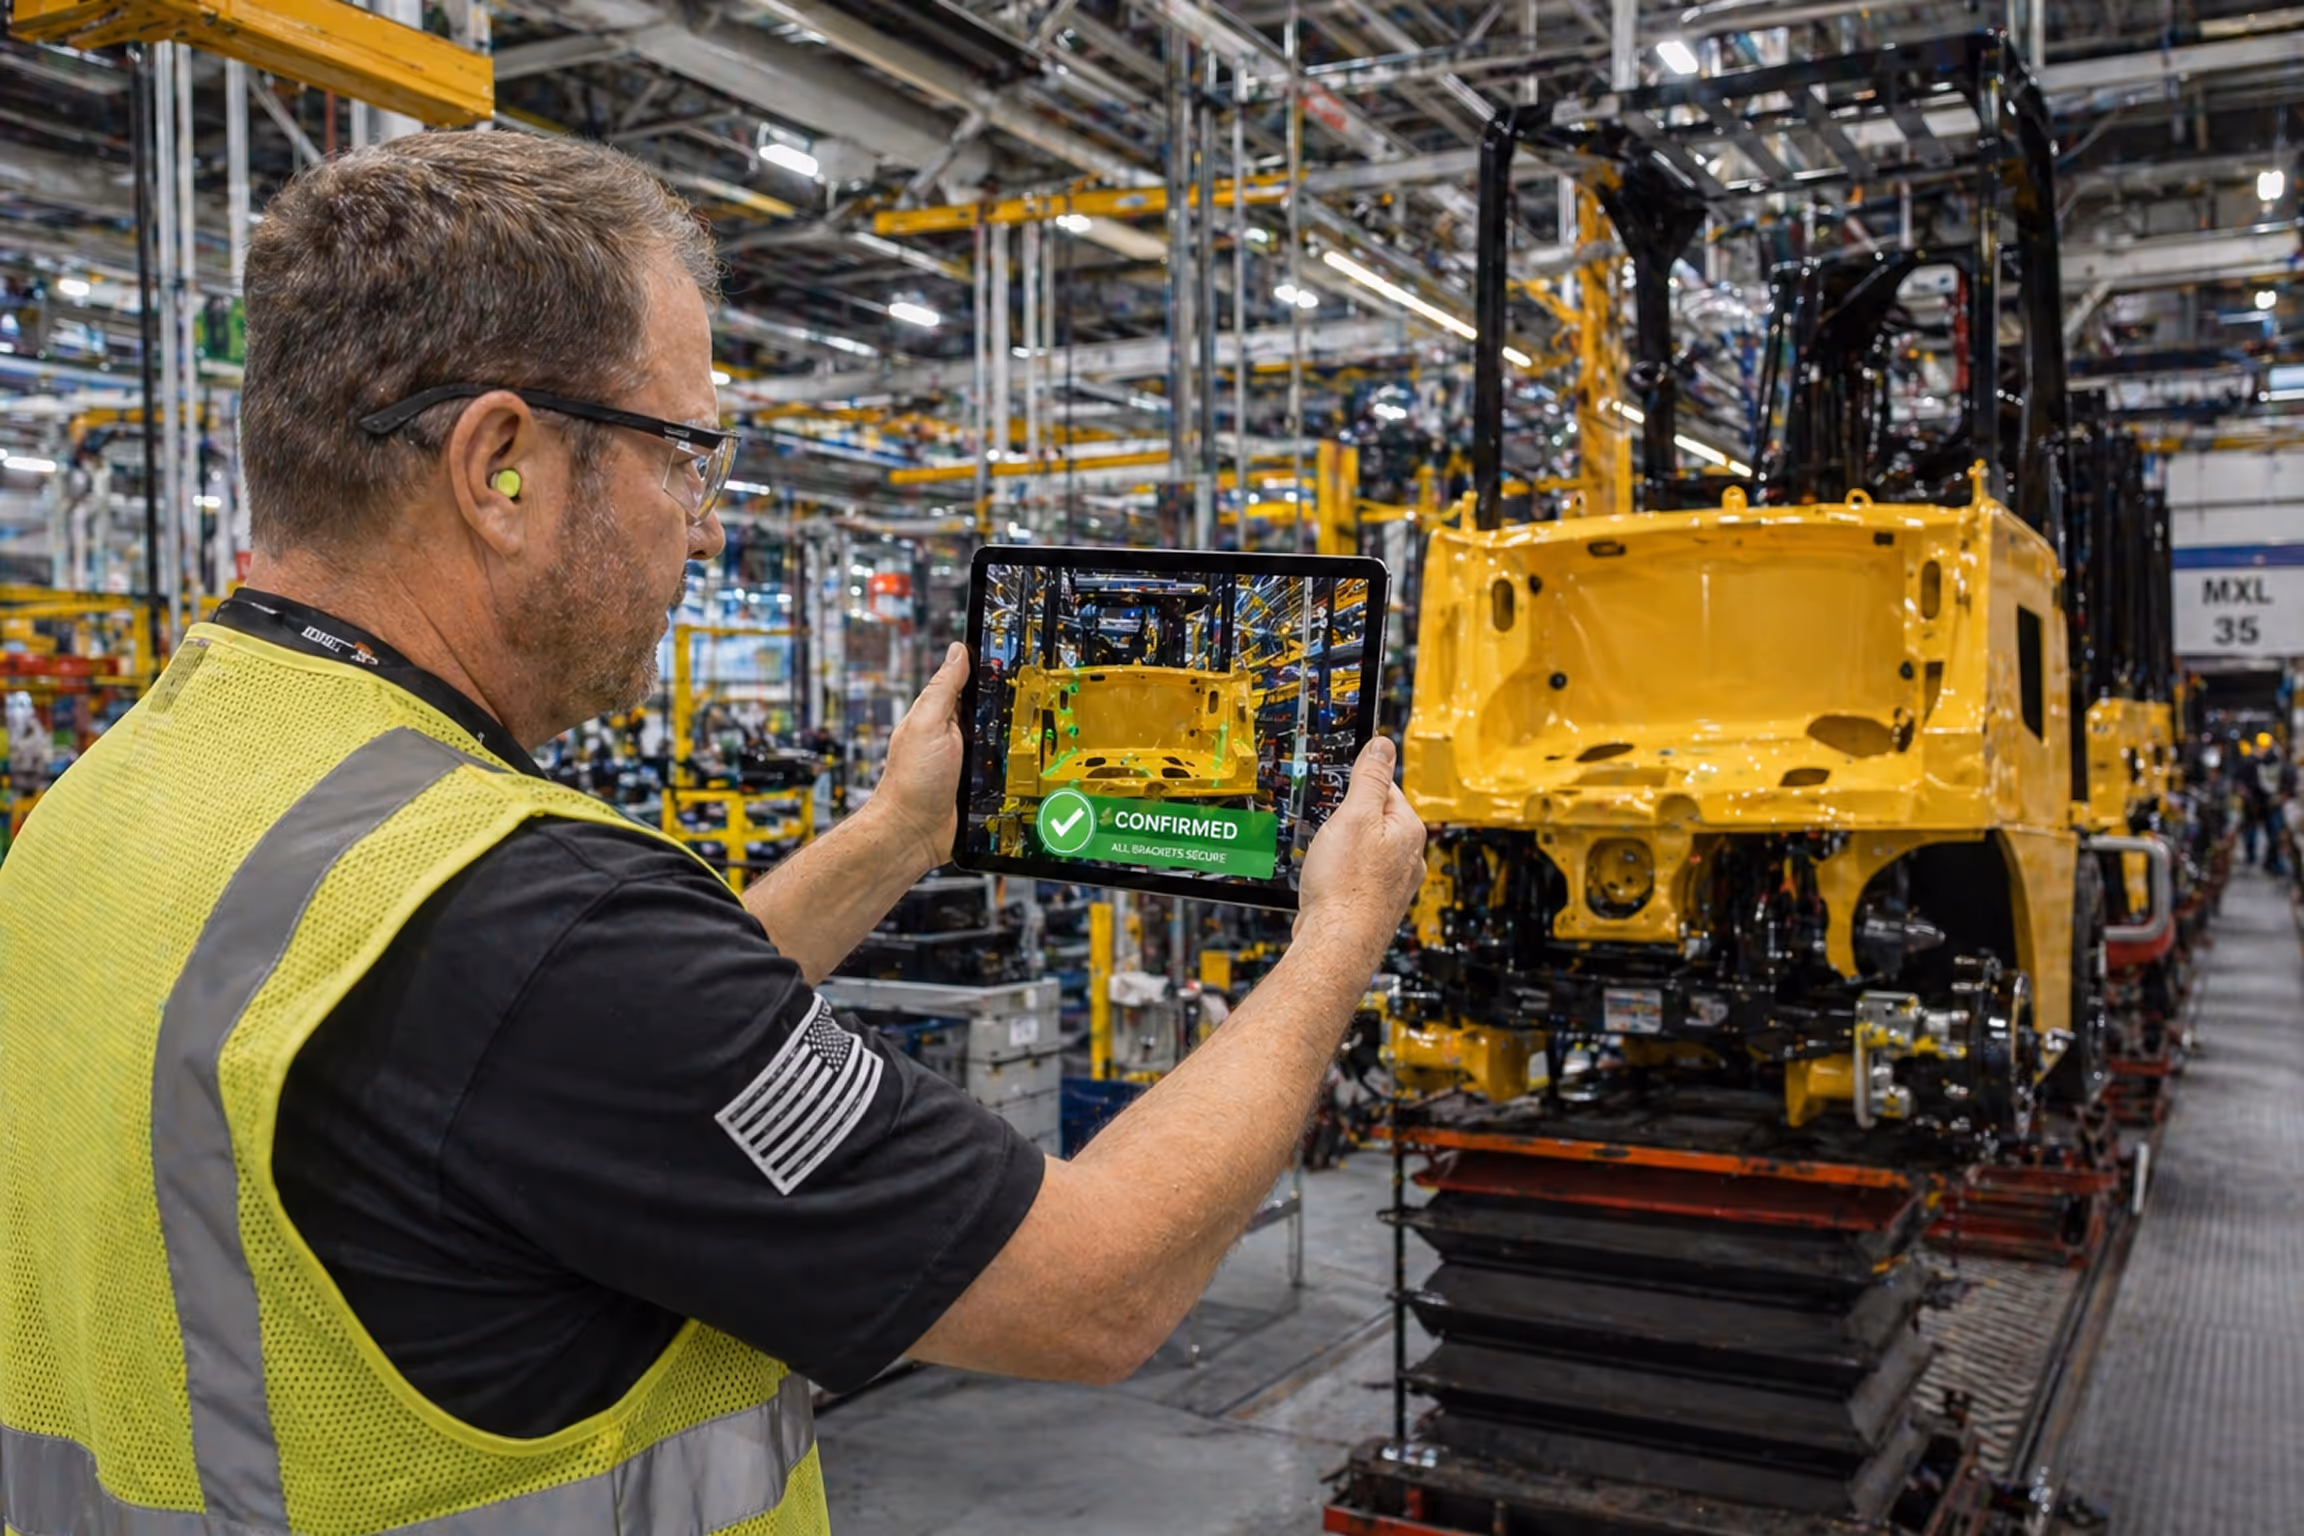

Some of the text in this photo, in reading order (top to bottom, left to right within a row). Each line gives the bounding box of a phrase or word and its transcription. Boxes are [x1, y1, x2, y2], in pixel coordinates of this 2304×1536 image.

[2202, 577, 2274, 606] MXL
[2213, 615, 2260, 646] 35
[1115, 811, 1238, 840] CONFIRMED
[1111, 843, 1130, 854] ALL
[1185, 849, 1227, 864] SECURE
